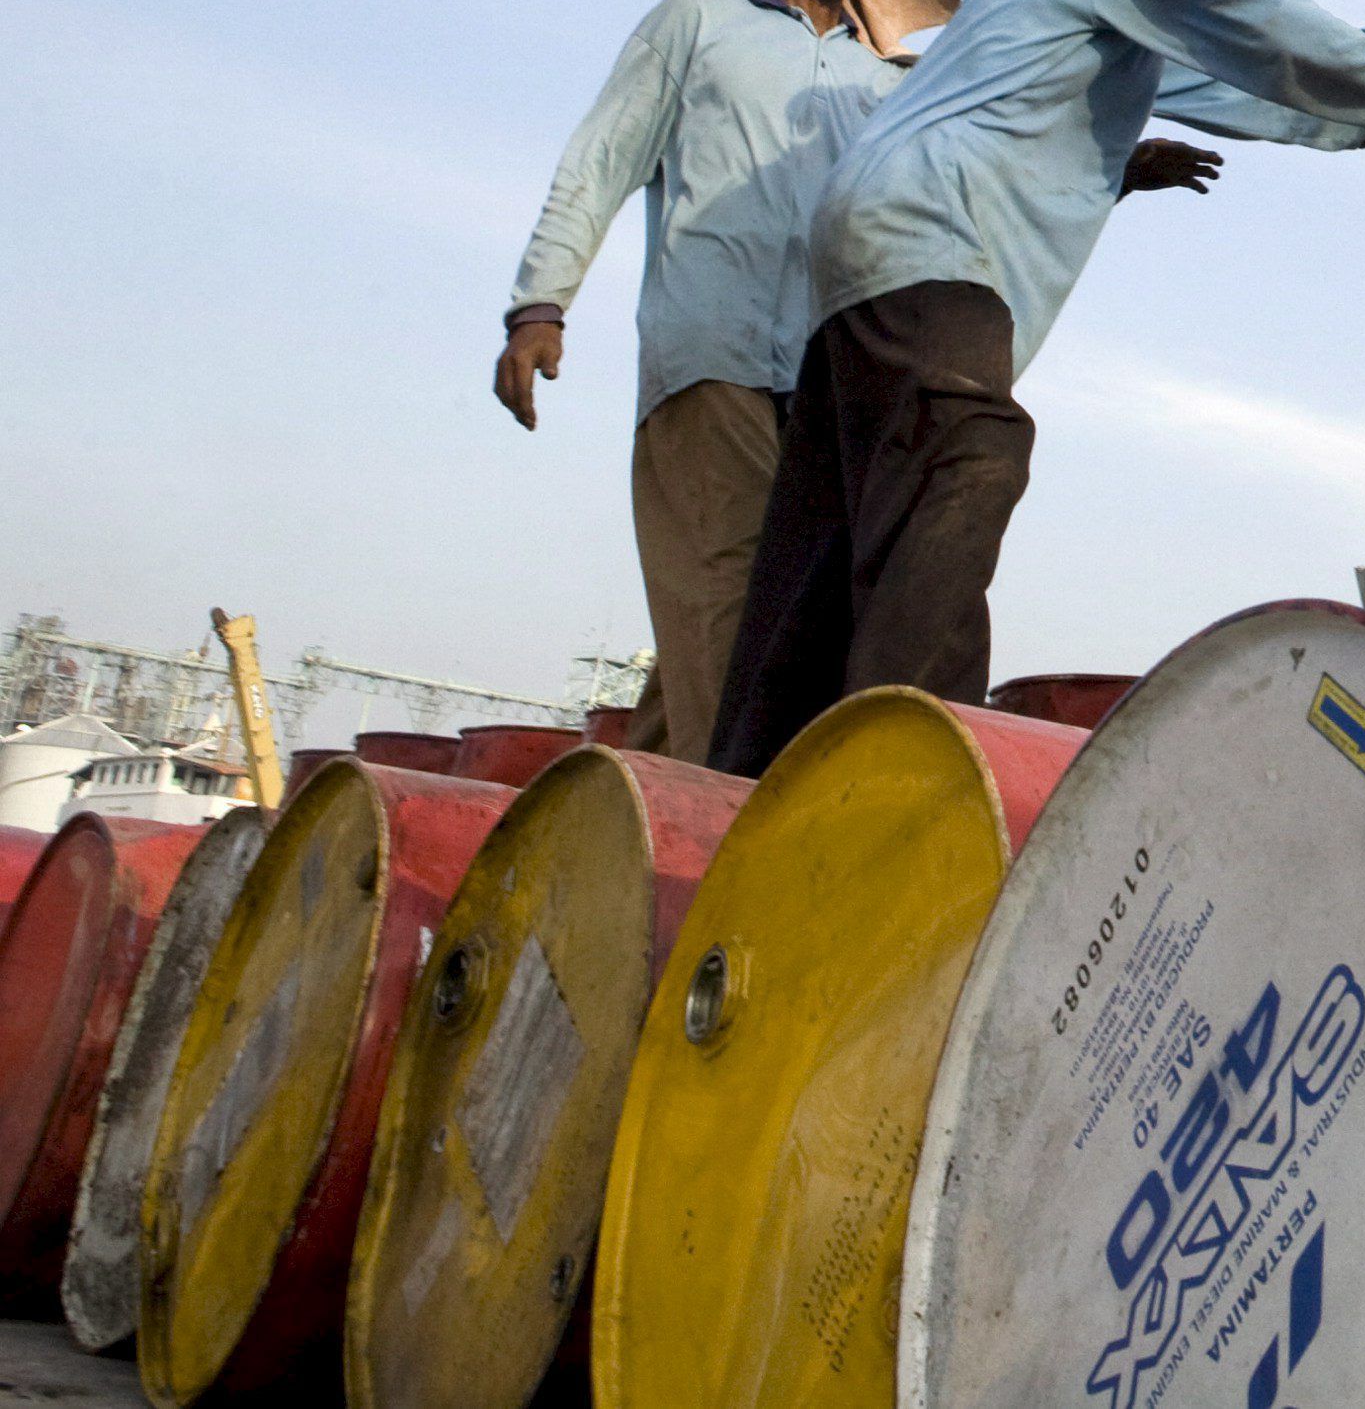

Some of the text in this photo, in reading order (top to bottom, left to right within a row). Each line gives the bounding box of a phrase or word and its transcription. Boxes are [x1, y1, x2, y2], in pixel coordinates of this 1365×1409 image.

[1051, 848, 1149, 1035] 01206082
[1074, 900, 1214, 1150] PRODUCED BY PERTAMINA
[1133, 1015, 1211, 1148] SAE 40
[1106, 982, 1281, 1291] 420
[1287, 1161, 1300, 1178] &
[1206, 1190, 1317, 1362] PERTAMINA
[1233, 1181, 1287, 1261] MARINE
[1189, 1265, 1233, 1332] DIESEL
